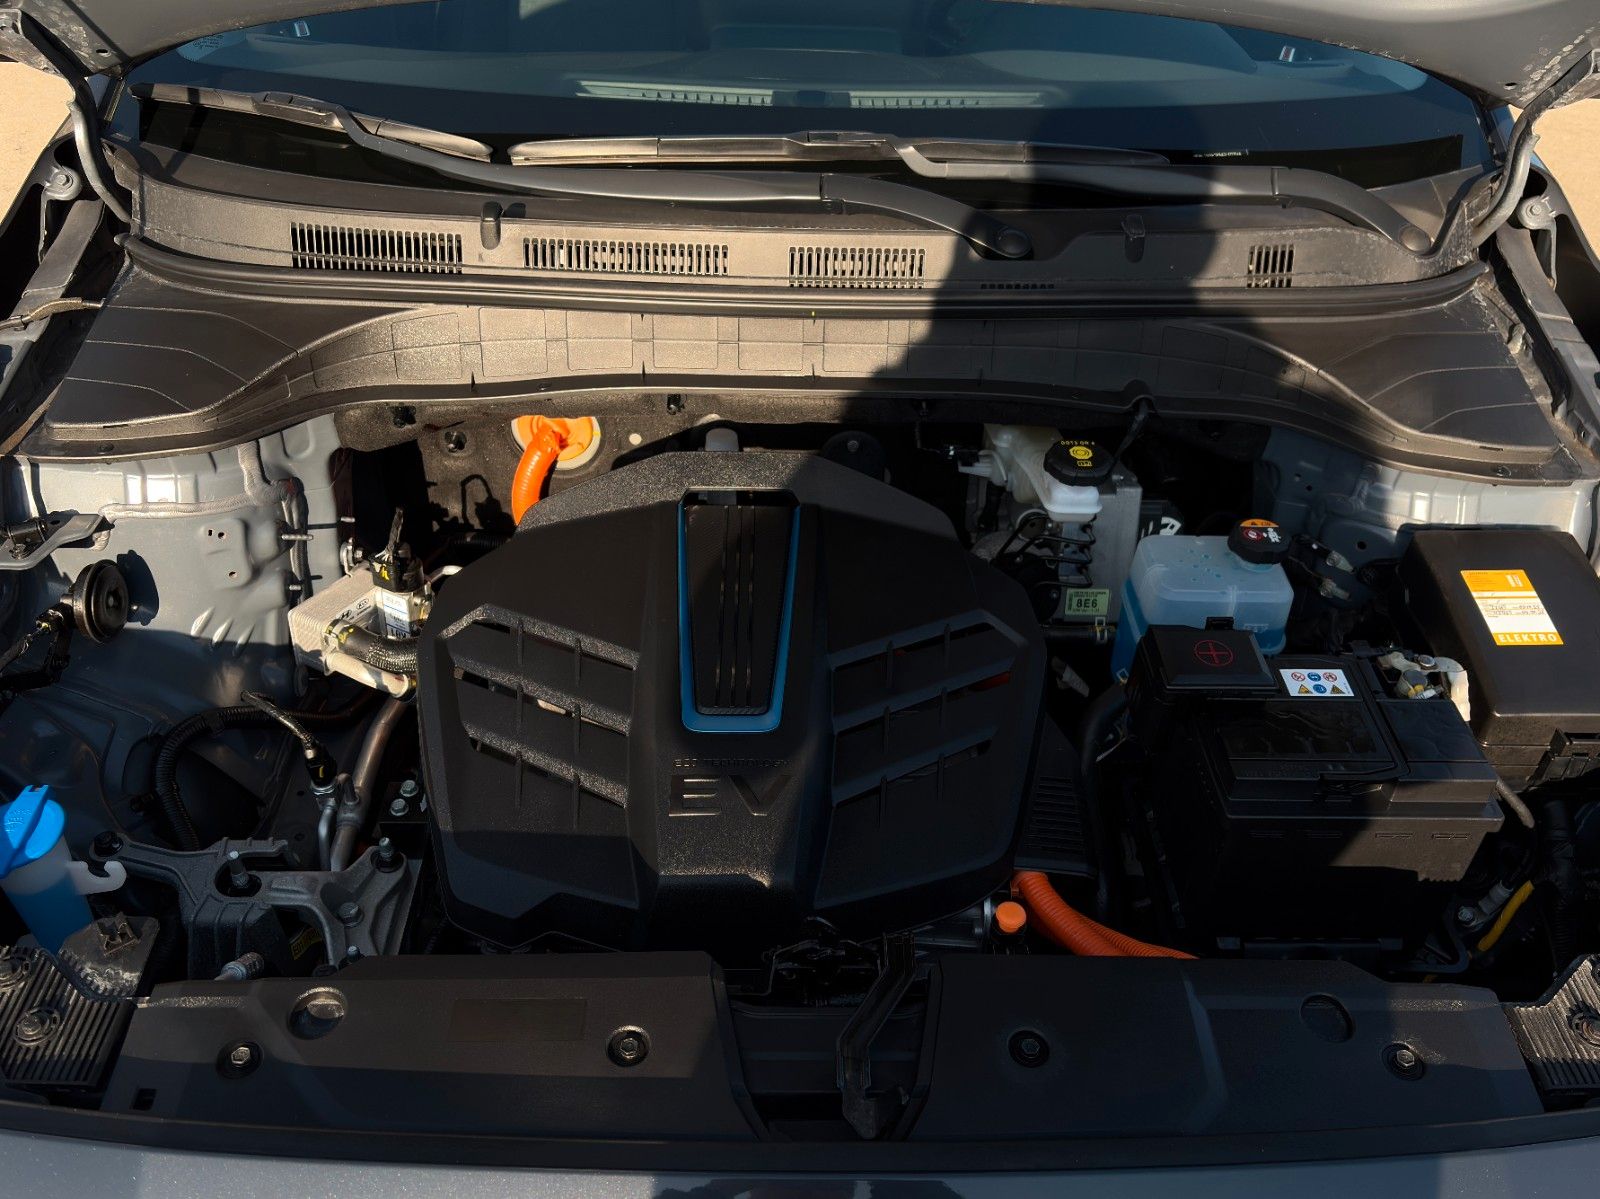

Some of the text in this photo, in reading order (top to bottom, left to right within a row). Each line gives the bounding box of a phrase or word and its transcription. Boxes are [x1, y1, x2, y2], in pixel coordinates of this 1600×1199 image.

[1076, 598, 1098, 608] 8E6
[1498, 633, 1557, 643] ELEKTRO
[669, 774, 793, 817] EV
